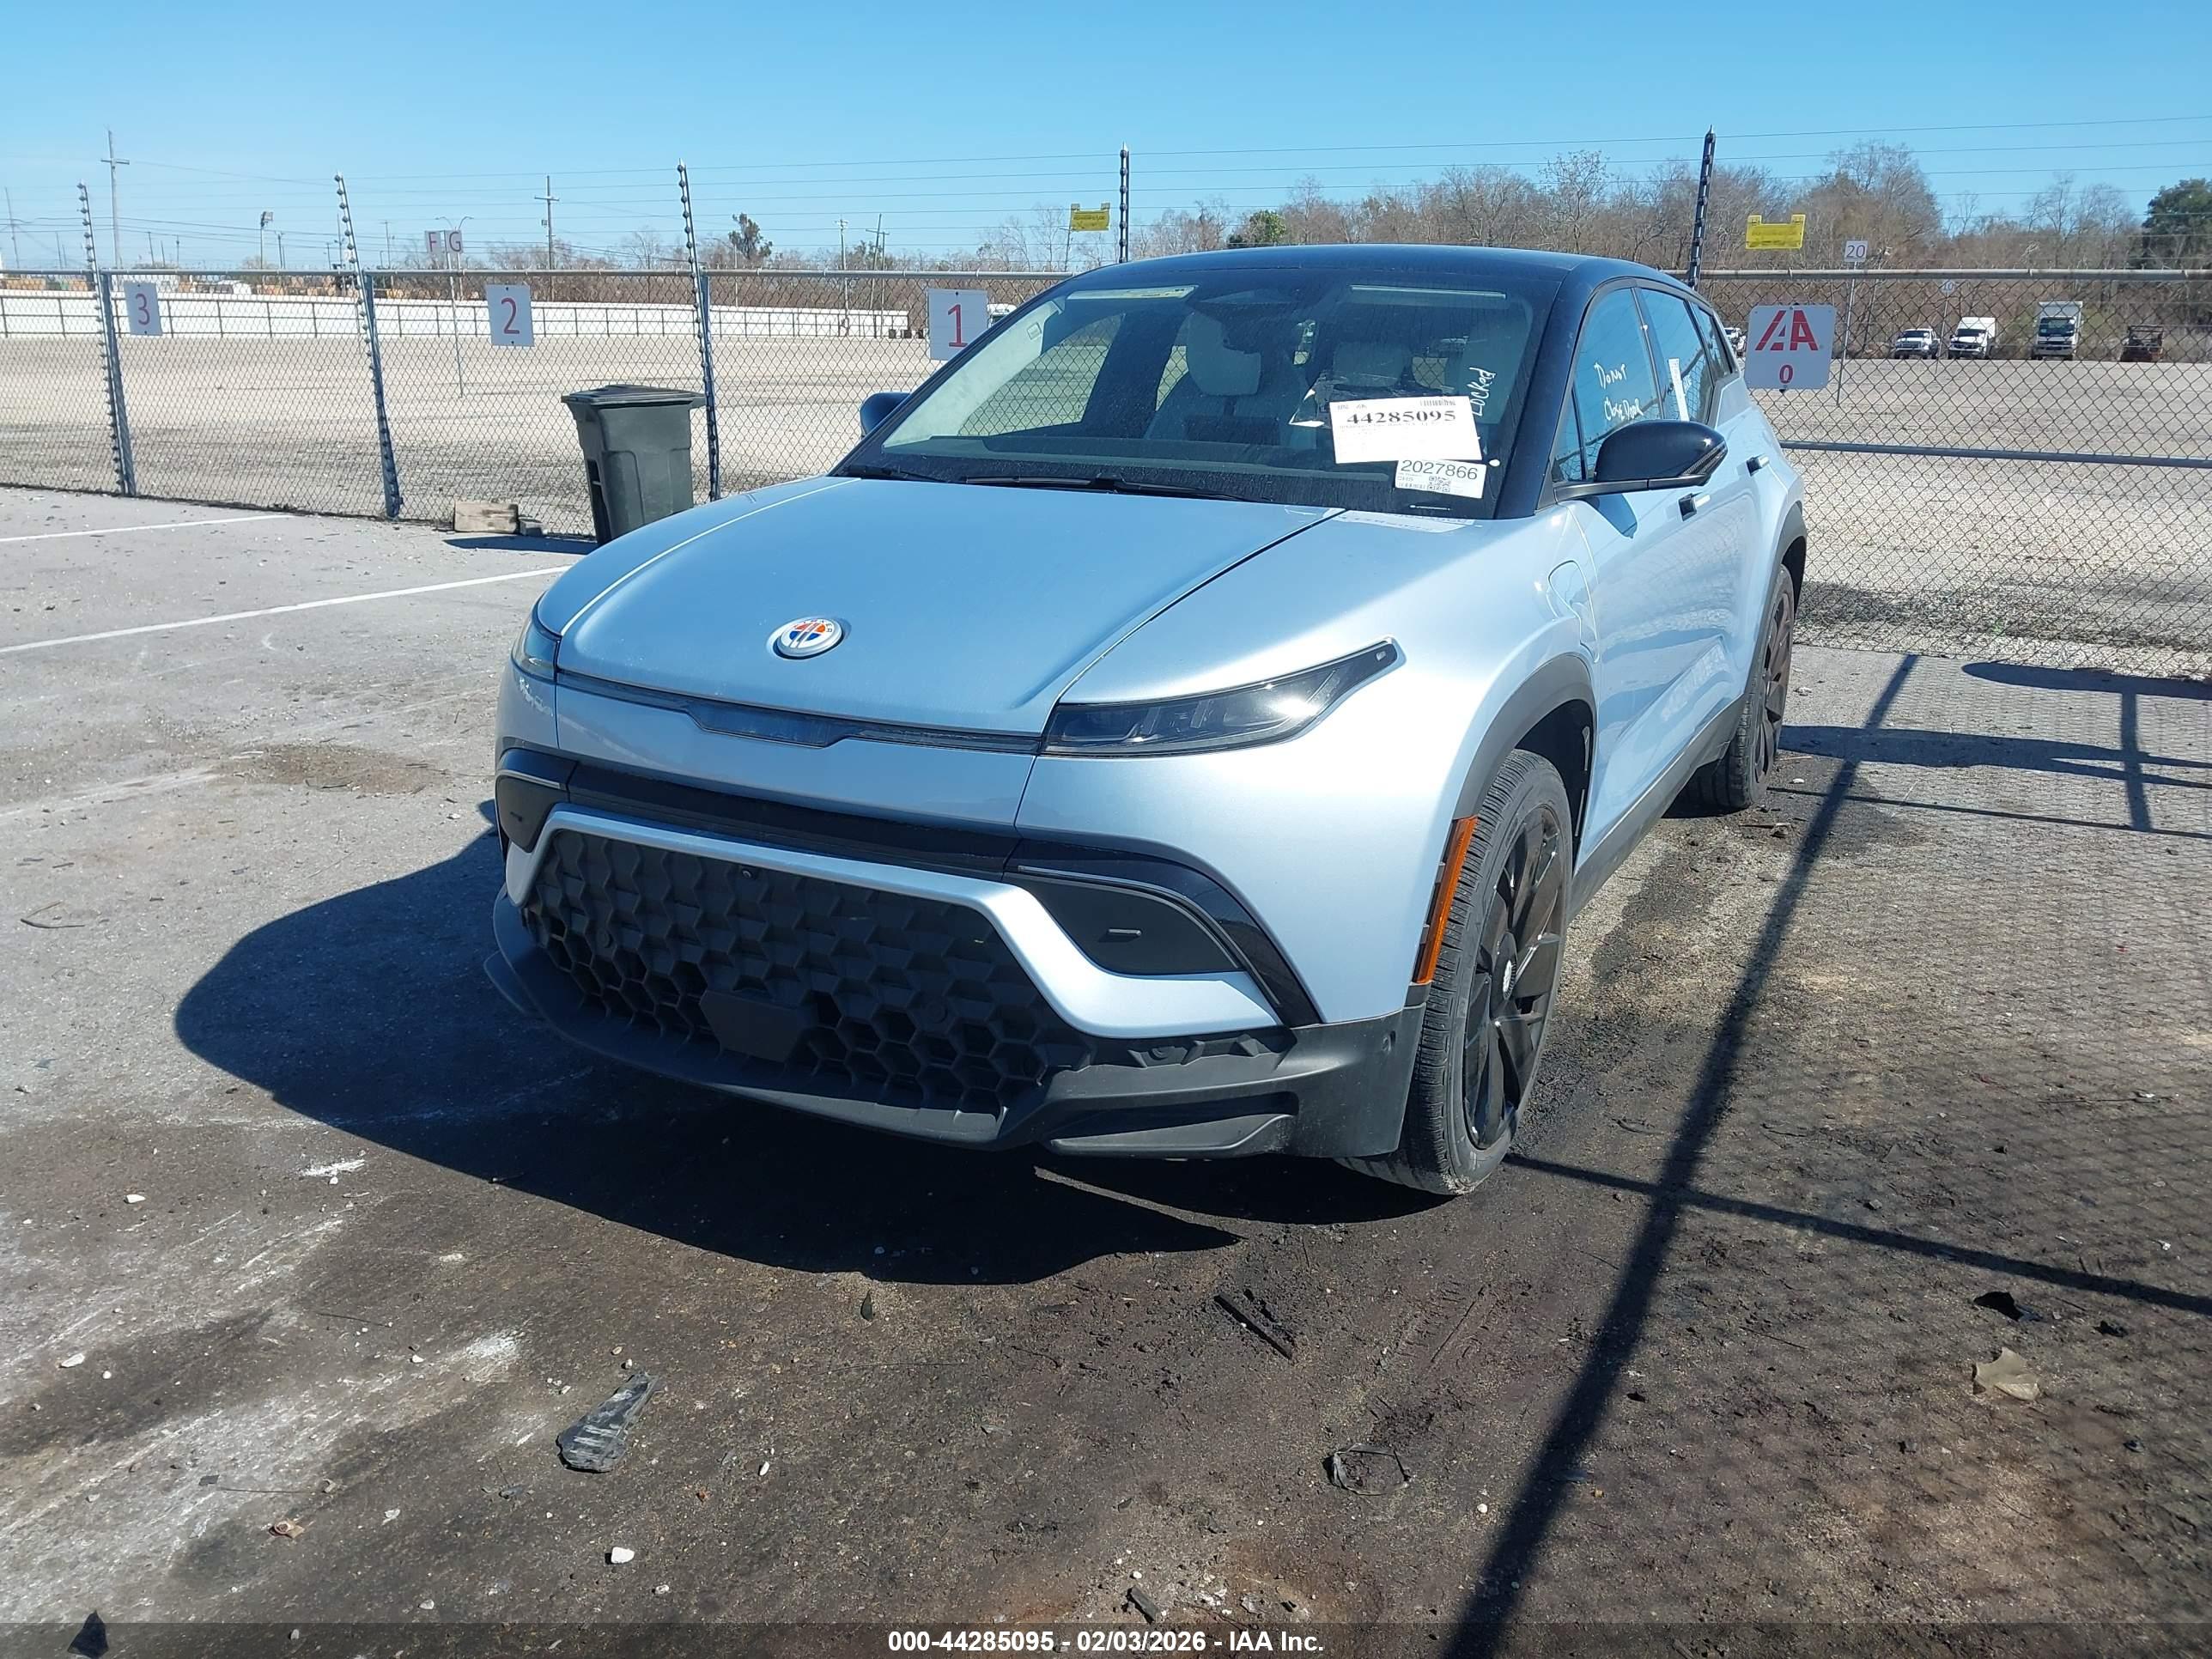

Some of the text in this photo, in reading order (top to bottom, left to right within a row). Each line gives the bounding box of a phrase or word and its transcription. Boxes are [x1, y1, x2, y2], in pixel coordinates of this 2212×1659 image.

[428, 231, 437, 252] F
[448, 231, 462, 252] G
[1846, 244, 1866, 258] 20
[135, 293, 150, 325] 3
[501, 297, 520, 335] 2
[947, 303, 969, 348] 1
[1346, 410, 1456, 424] 44285095
[1400, 459, 1479, 480] 2027866
